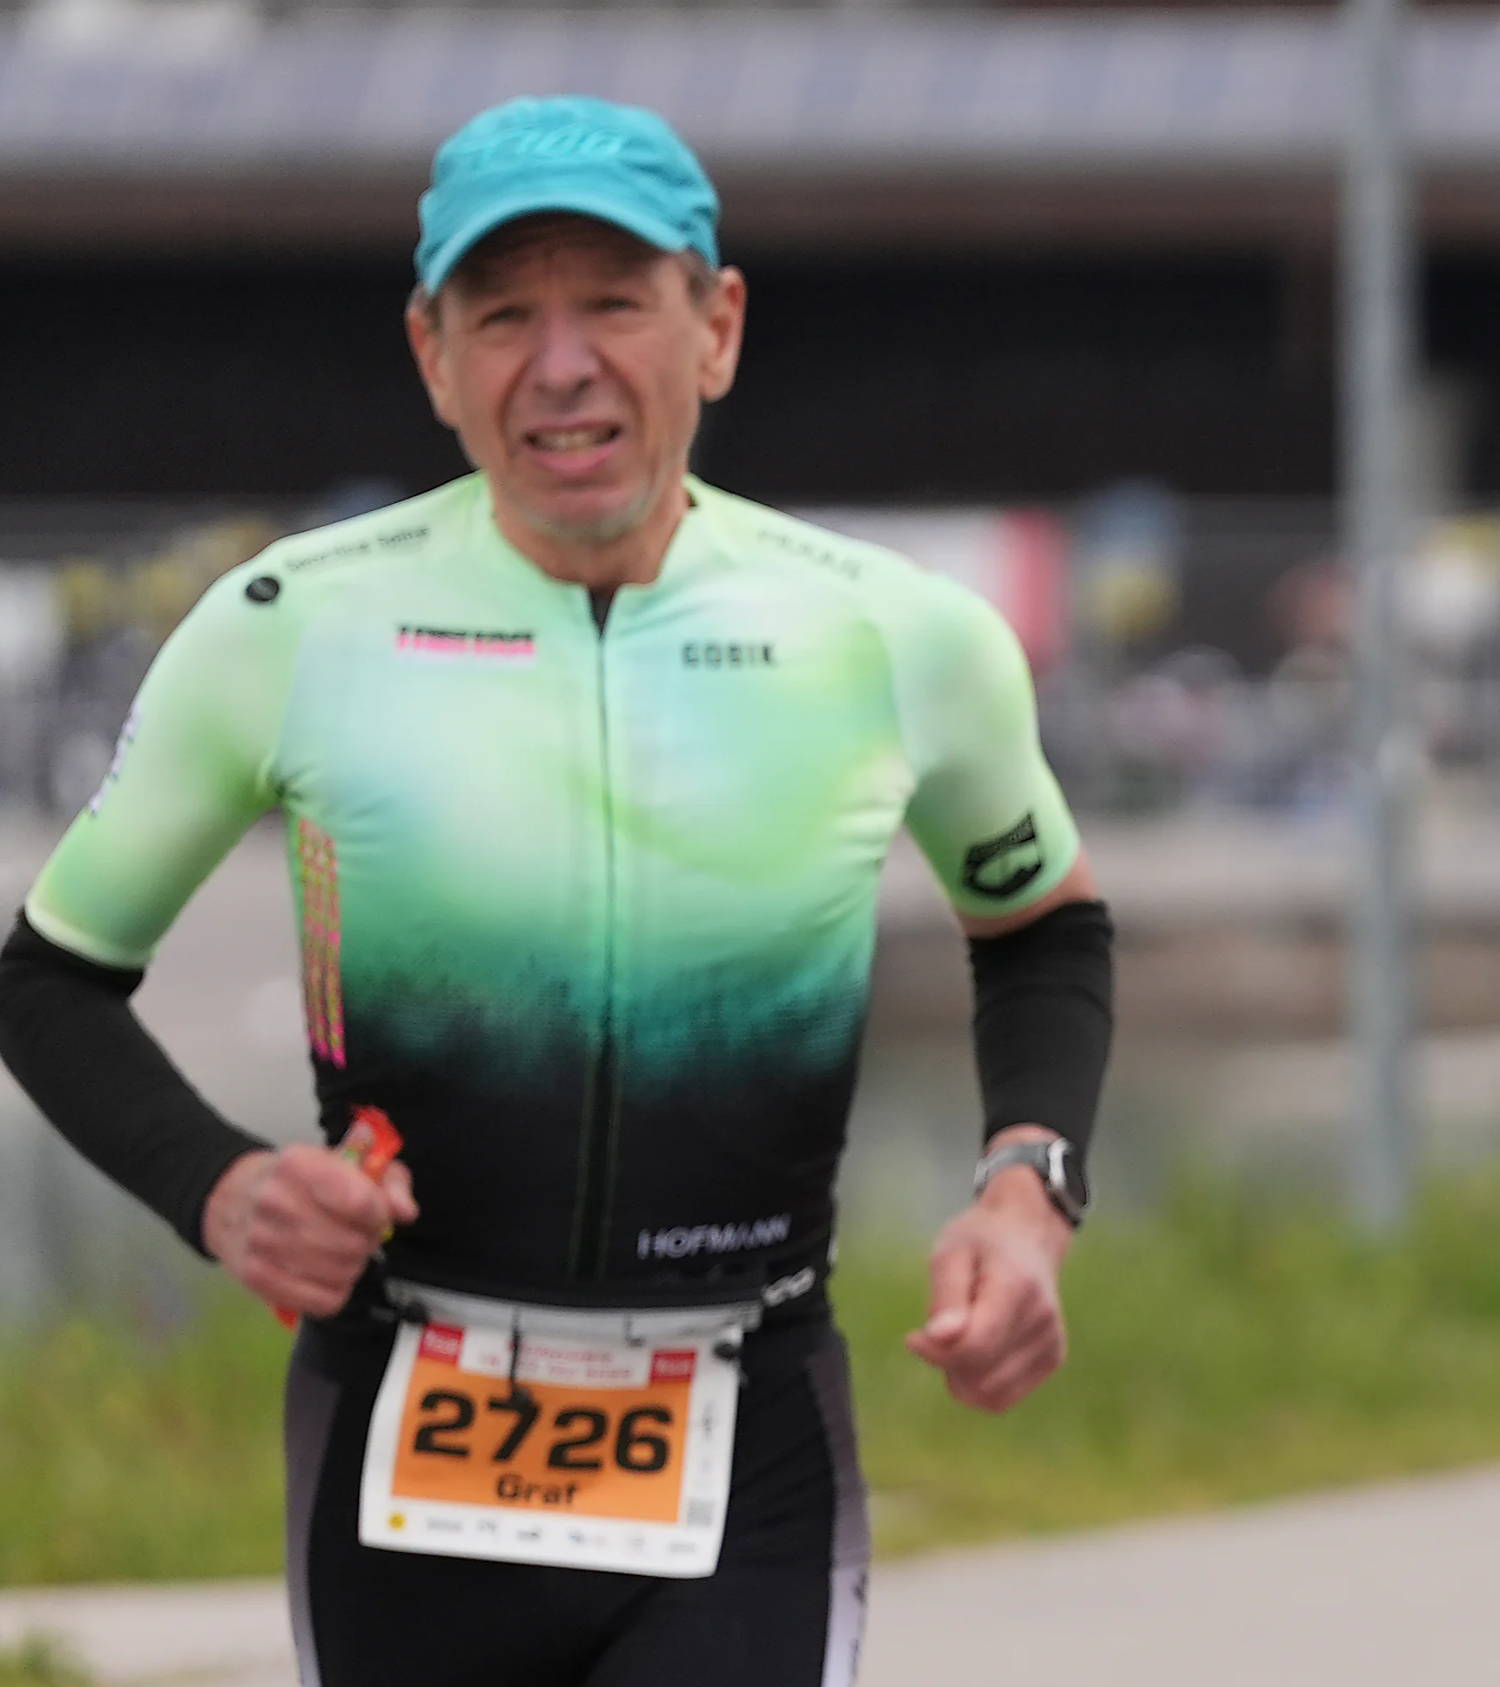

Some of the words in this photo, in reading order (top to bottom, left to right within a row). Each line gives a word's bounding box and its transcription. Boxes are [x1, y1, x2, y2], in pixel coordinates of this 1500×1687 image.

[637, 1216, 790, 1259] HOFMANN
[414, 1389, 673, 1473] 2726
[496, 1473, 578, 1507] Graf
